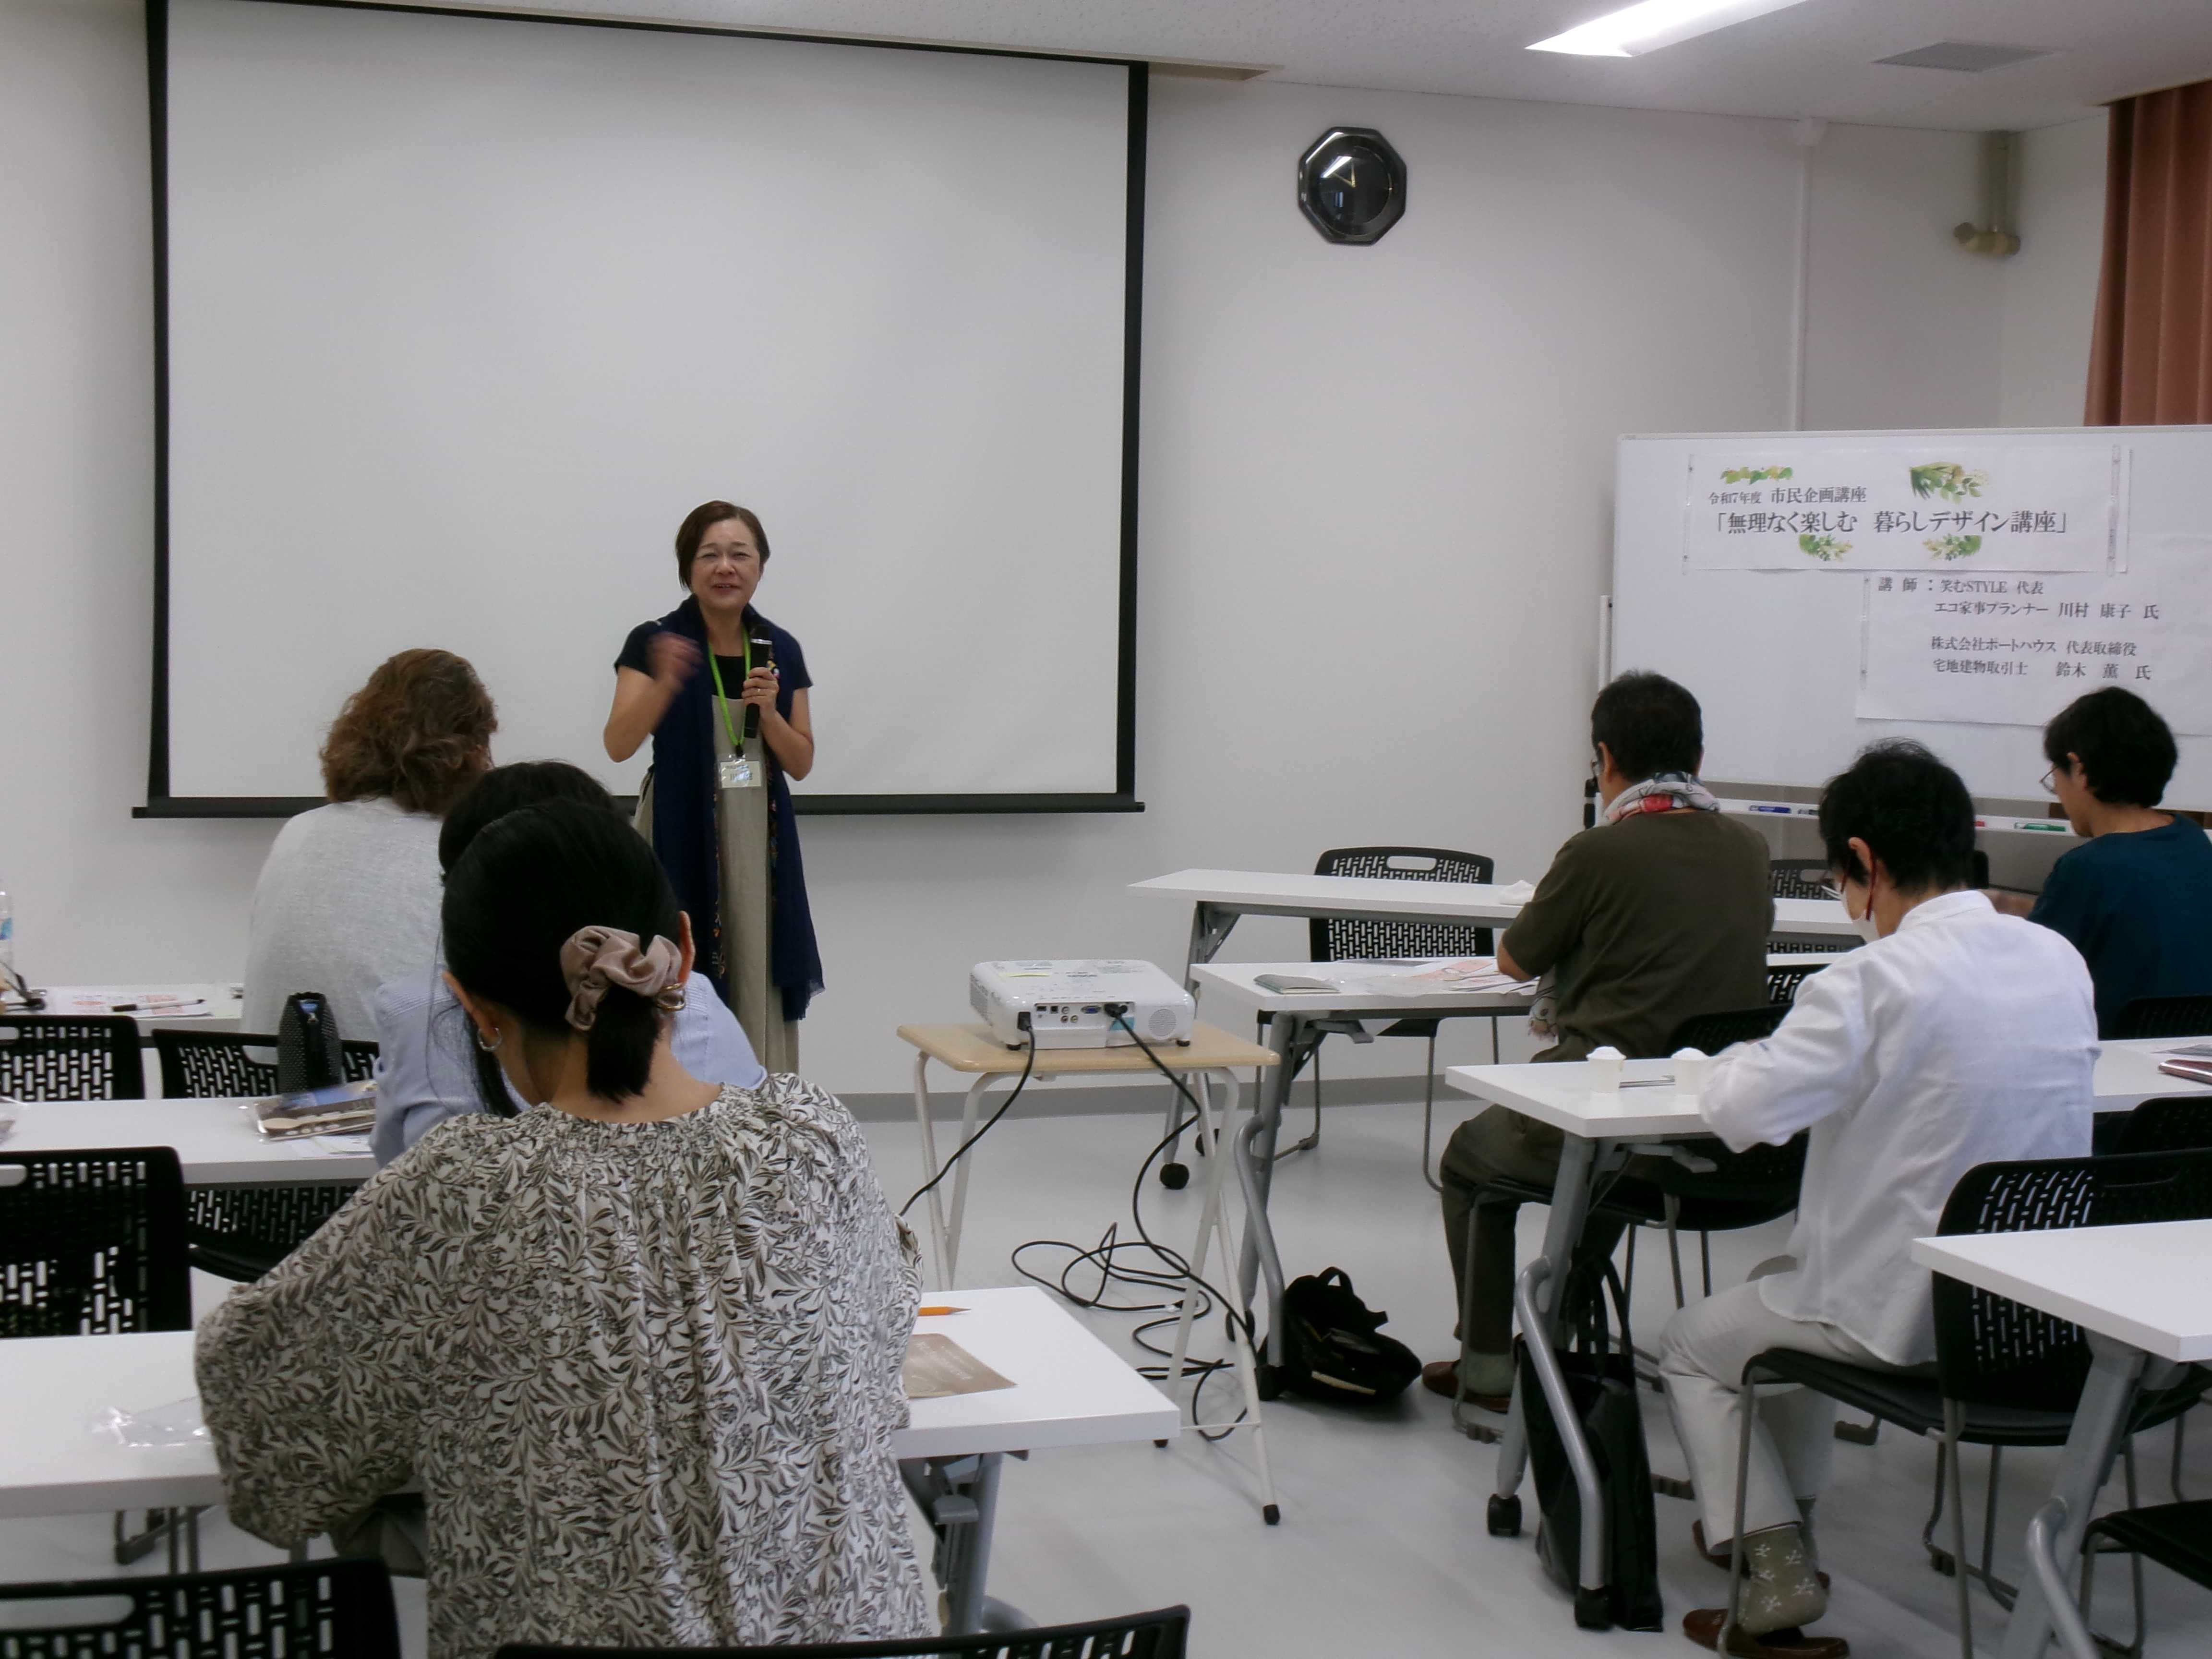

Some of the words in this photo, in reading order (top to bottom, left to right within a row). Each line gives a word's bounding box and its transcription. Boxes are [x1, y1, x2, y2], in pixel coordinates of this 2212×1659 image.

[1770, 486, 1867, 504] 市民企画講座
[1718, 511, 1858, 534] 「無理なく楽しむ
[1874, 510, 2067, 534] 暮らしデザイン講座」
[2017, 580, 2044, 595] 代表
[2058, 602, 2089, 618] 川村
[2100, 603, 2132, 619] 康子
[2143, 604, 2159, 620] 氏
[2067, 640, 2137, 657] 代表取締役
[2056, 661, 2087, 677] 鈴木
[2135, 665, 2152, 680] 氏
